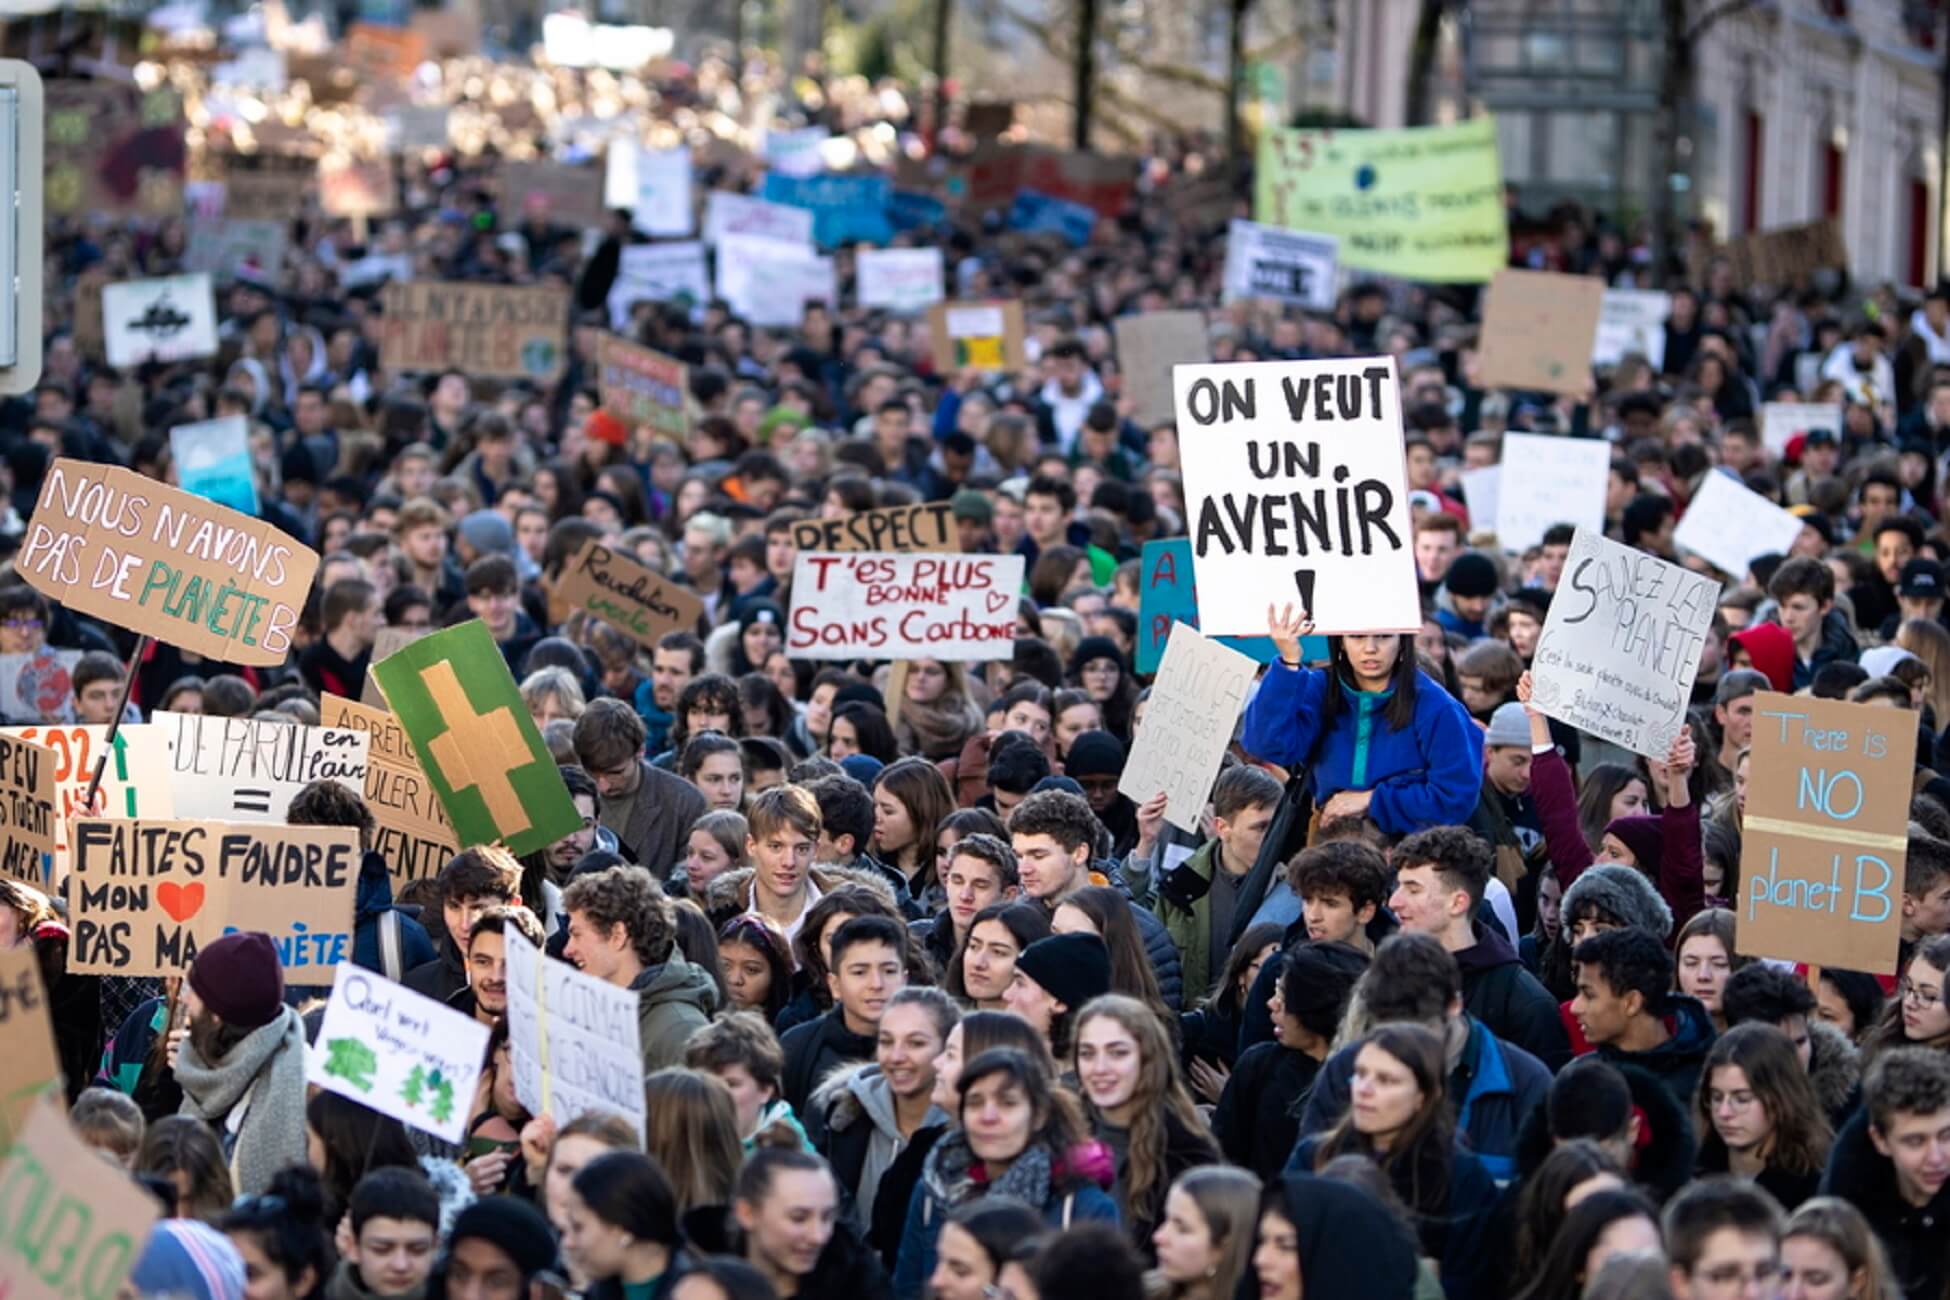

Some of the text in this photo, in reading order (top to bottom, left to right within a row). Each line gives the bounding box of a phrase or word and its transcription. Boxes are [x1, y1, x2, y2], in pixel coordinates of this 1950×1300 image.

[1187, 367, 1390, 425] ON VEUT
[1246, 440, 1321, 479] UN
[43, 468, 294, 586] NOUS N'AVONS
[23, 524, 299, 653] PAS DE PLANÈTE B
[808, 557, 994, 592] T'es PLUS
[866, 584, 949, 606] BONNE
[1667, 572, 1704, 625] LA
[20, 728, 95, 783] O2
[322, 731, 361, 748] en
[1761, 711, 1888, 759] There is
[308, 750, 367, 780] l'air
[1797, 767, 1866, 820] NO
[220, 835, 352, 887] FONDRE
[1750, 847, 1894, 922] planet B
[80, 879, 149, 913] MON
[75, 920, 131, 967] PAS
[155, 923, 199, 969] MA
